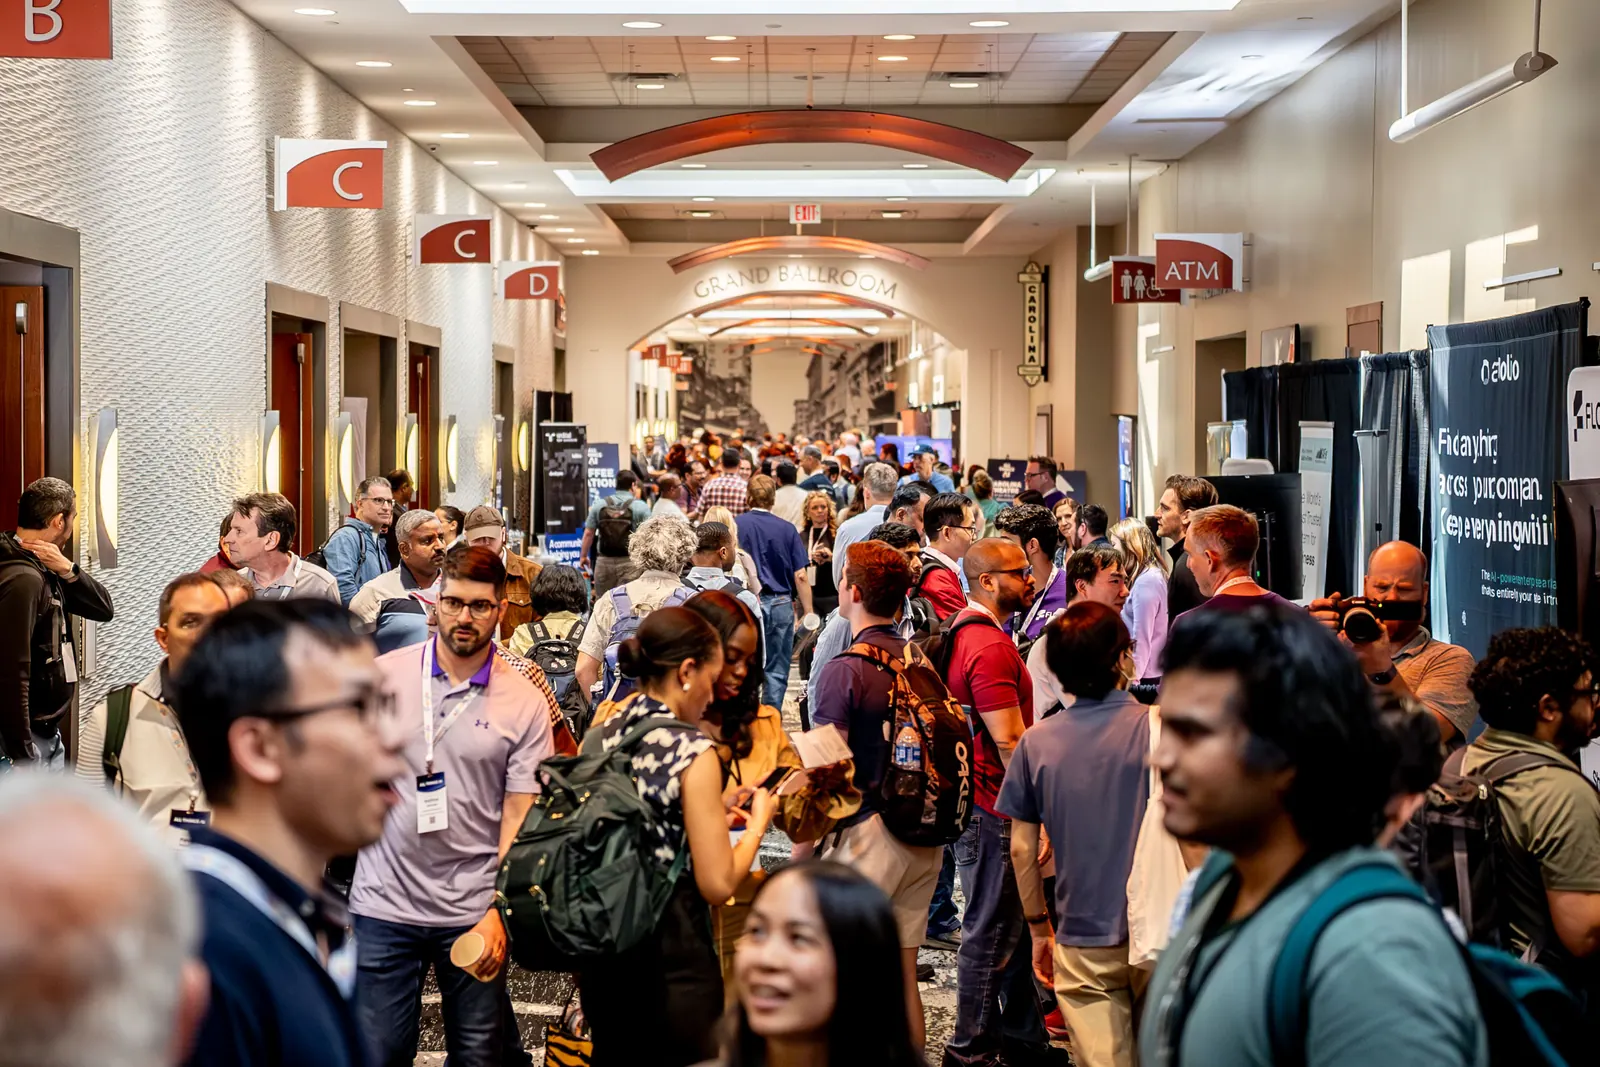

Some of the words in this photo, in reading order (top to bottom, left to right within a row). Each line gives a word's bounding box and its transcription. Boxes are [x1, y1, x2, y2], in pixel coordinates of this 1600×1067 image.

[24, 0, 64, 43] B
[332, 161, 364, 201] C
[795, 204, 817, 221] EXIT
[453, 229, 477, 259] C
[529, 273, 549, 296] D
[693, 266, 771, 298] GRAND
[778, 264, 899, 300] BALLROOM
[1164, 261, 1220, 281] ATM
[1027, 285, 1037, 363] CAROLINA
[954, 741, 970, 832] OAKLEY
